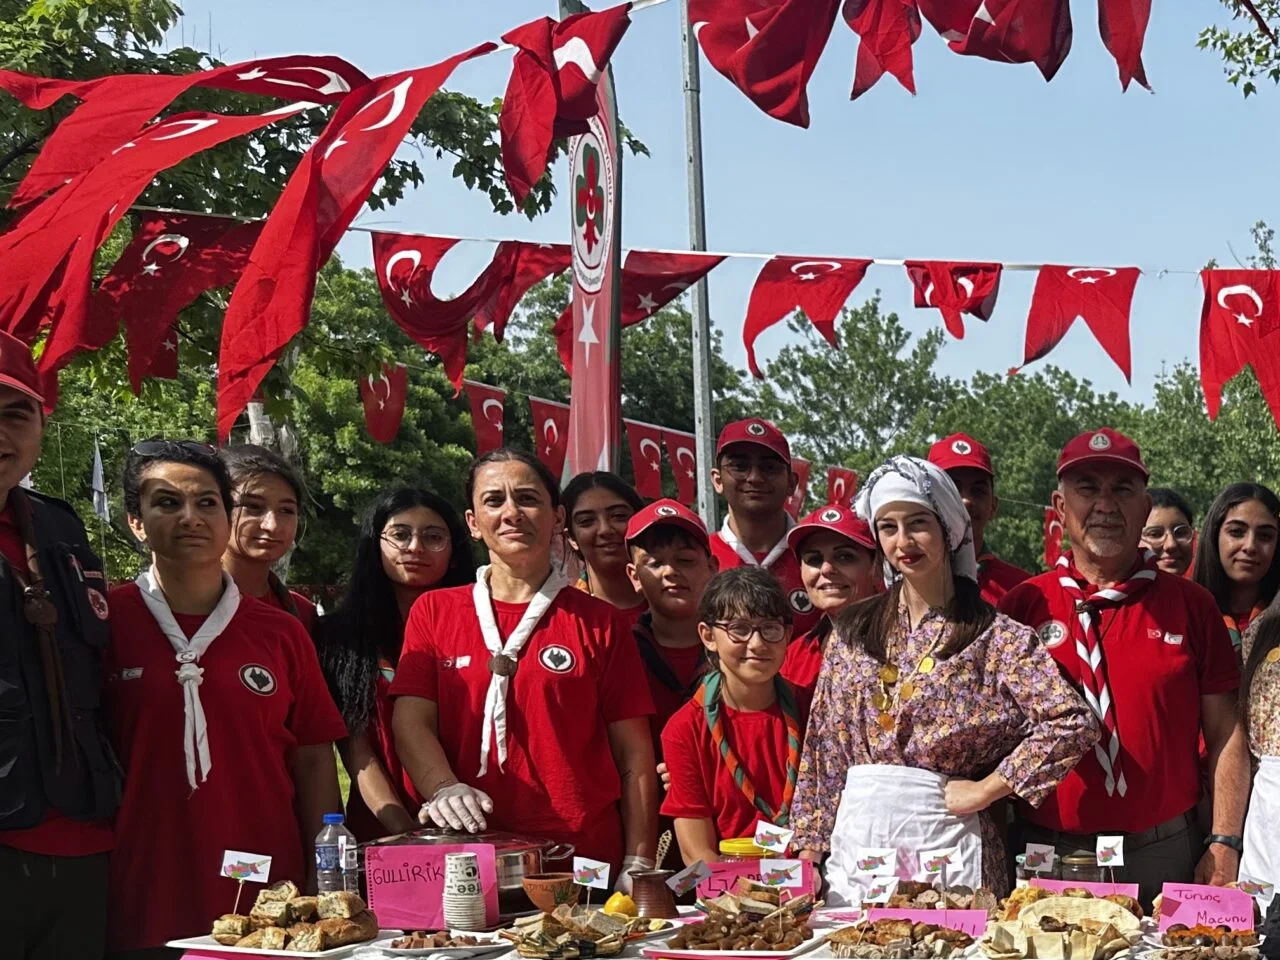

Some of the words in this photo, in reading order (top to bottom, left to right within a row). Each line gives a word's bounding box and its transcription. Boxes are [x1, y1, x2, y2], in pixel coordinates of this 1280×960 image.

[372, 862, 445, 885] GULLİRİK
[1173, 889, 1221, 904] Turunç
[1196, 910, 1247, 925] Macunu
